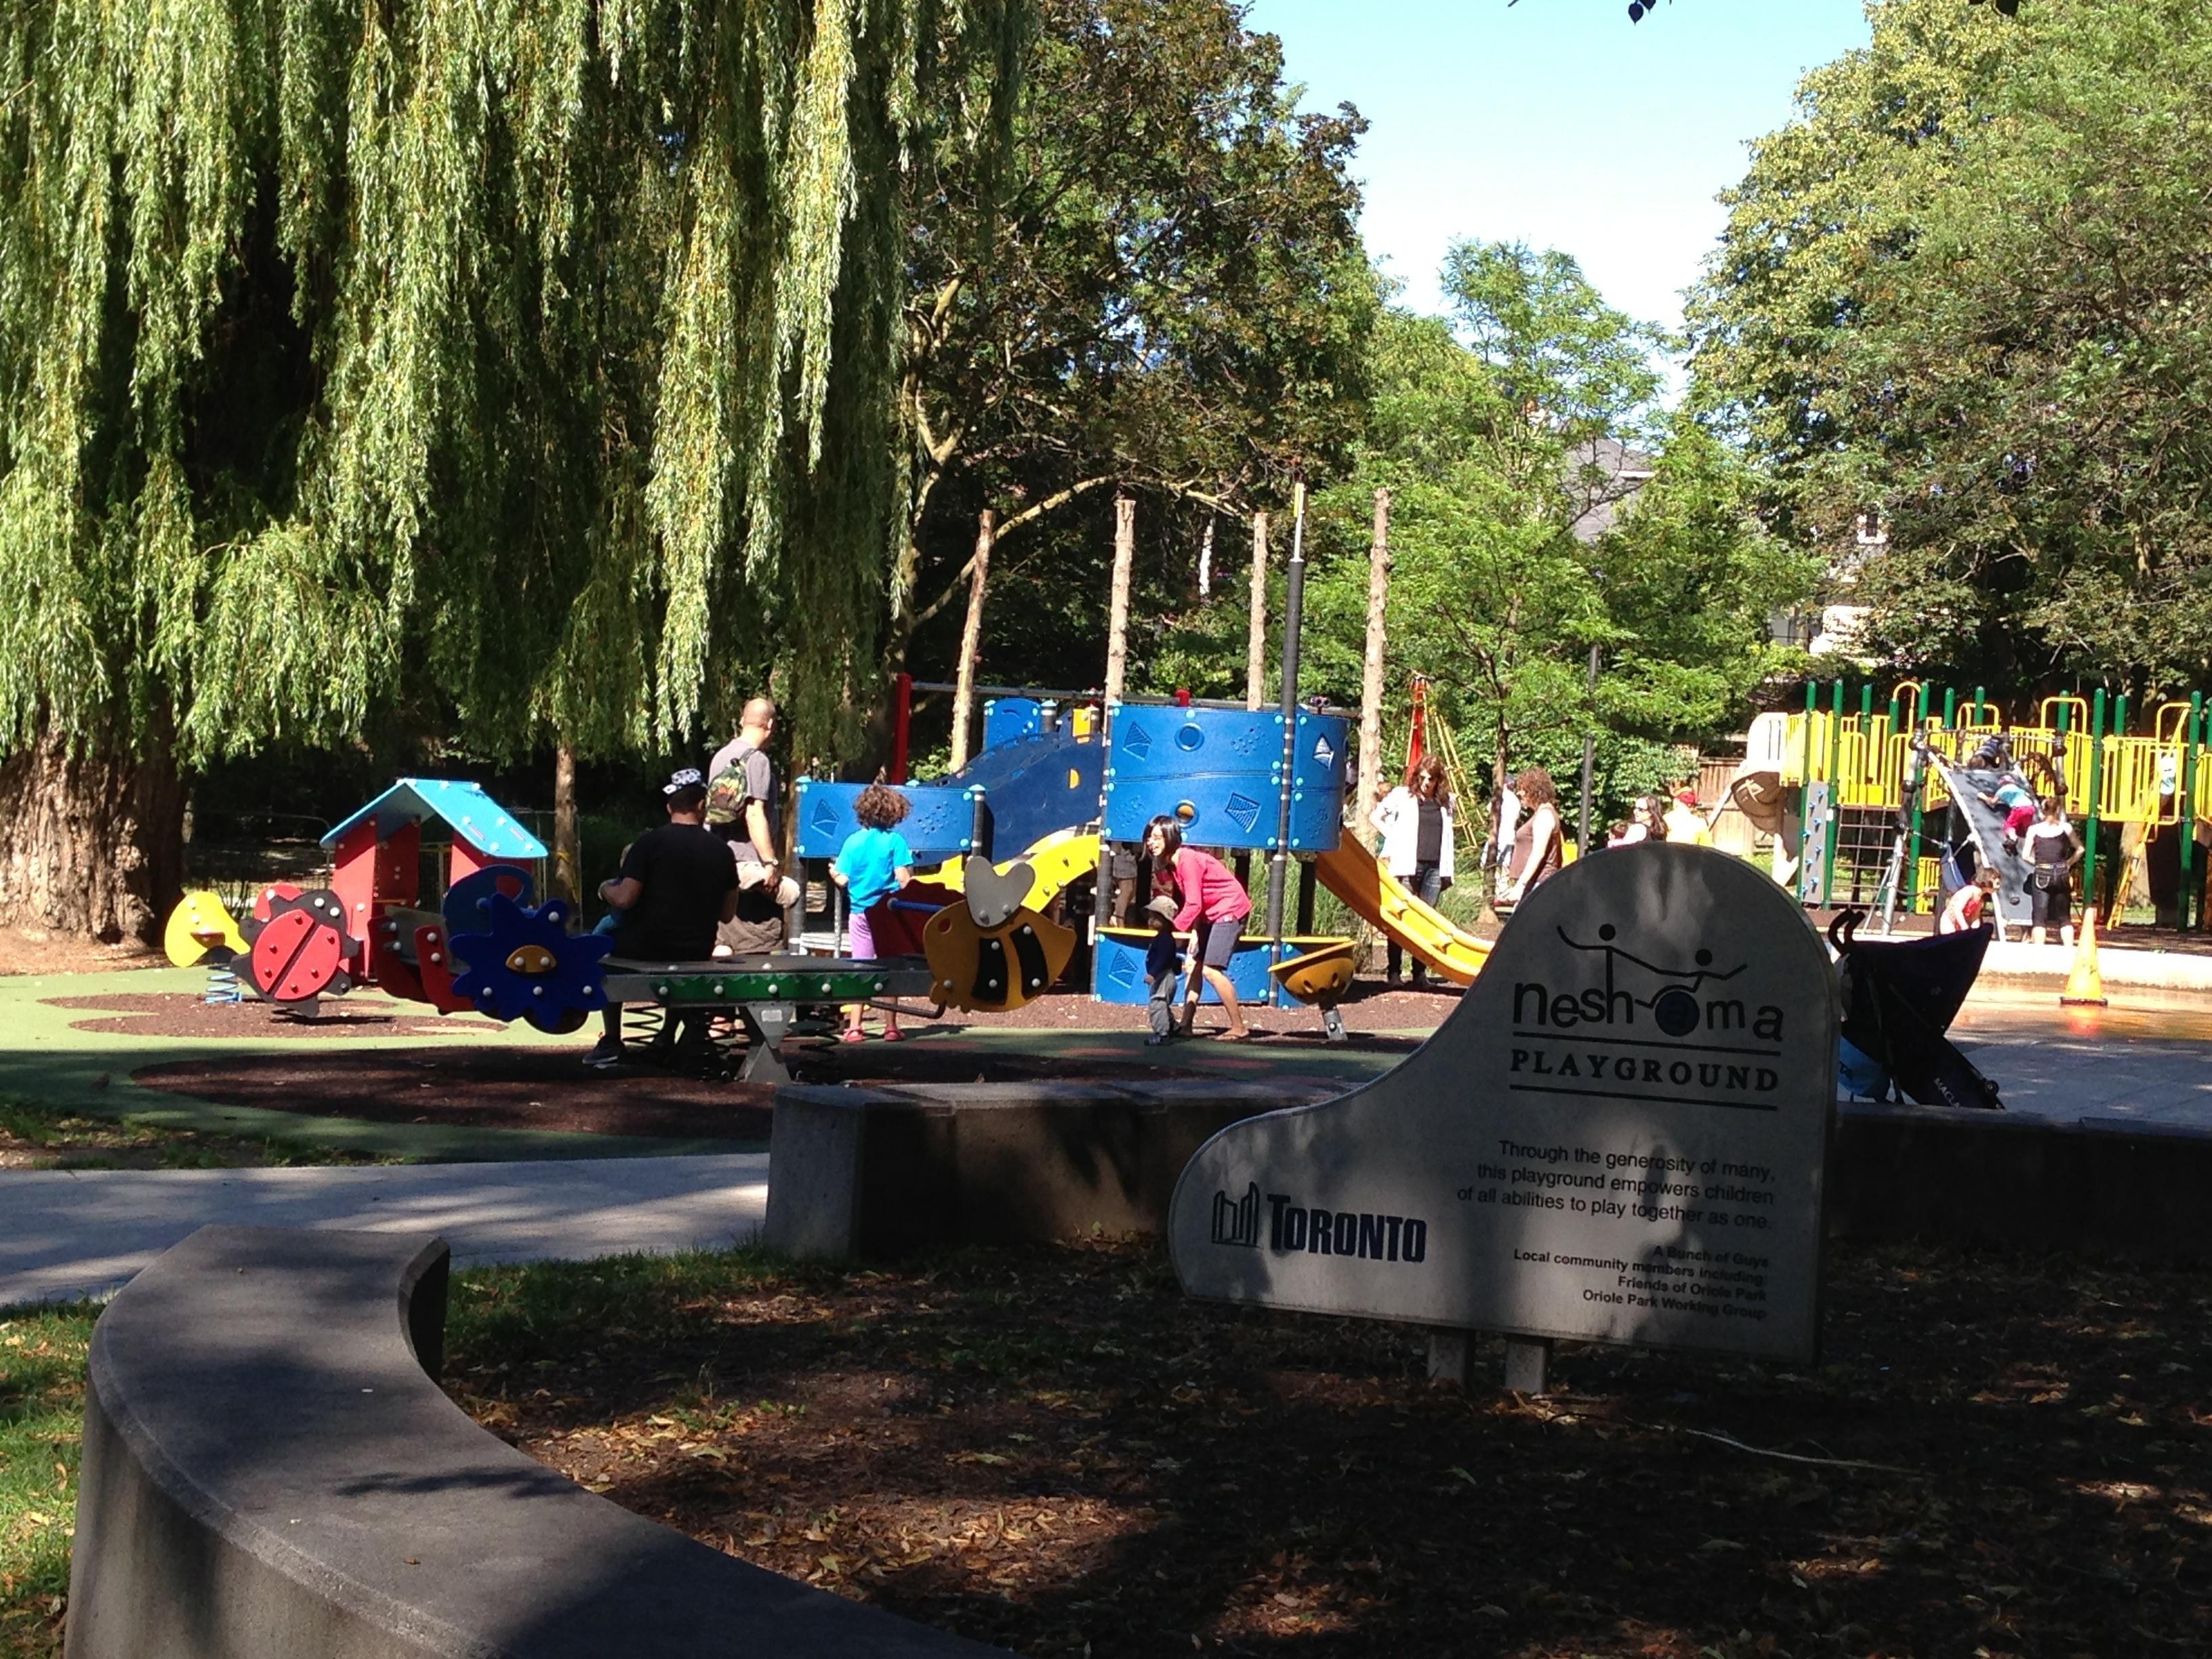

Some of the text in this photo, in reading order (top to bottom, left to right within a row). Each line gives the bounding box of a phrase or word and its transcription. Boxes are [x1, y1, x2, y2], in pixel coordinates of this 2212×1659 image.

[1510, 1049, 1779, 1092] PLAYGROUND
[1498, 1140, 1776, 1183] Through the generosity of many,
[1477, 1163, 1774, 1204] this playground empowers children
[1267, 1193, 1427, 1263] TORONTO
[1457, 1186, 1772, 1230] of all abilities to play together as one.
[1513, 1248, 1551, 1263] Local
[1553, 1254, 1629, 1273] community
[1632, 1261, 1694, 1277] members
[1653, 1246, 1769, 1269] A Bunch of Guys
[1582, 1288, 1767, 1321] Oriole Park Working Group
[1618, 1275, 1767, 1301] Friends of Oriole Park
